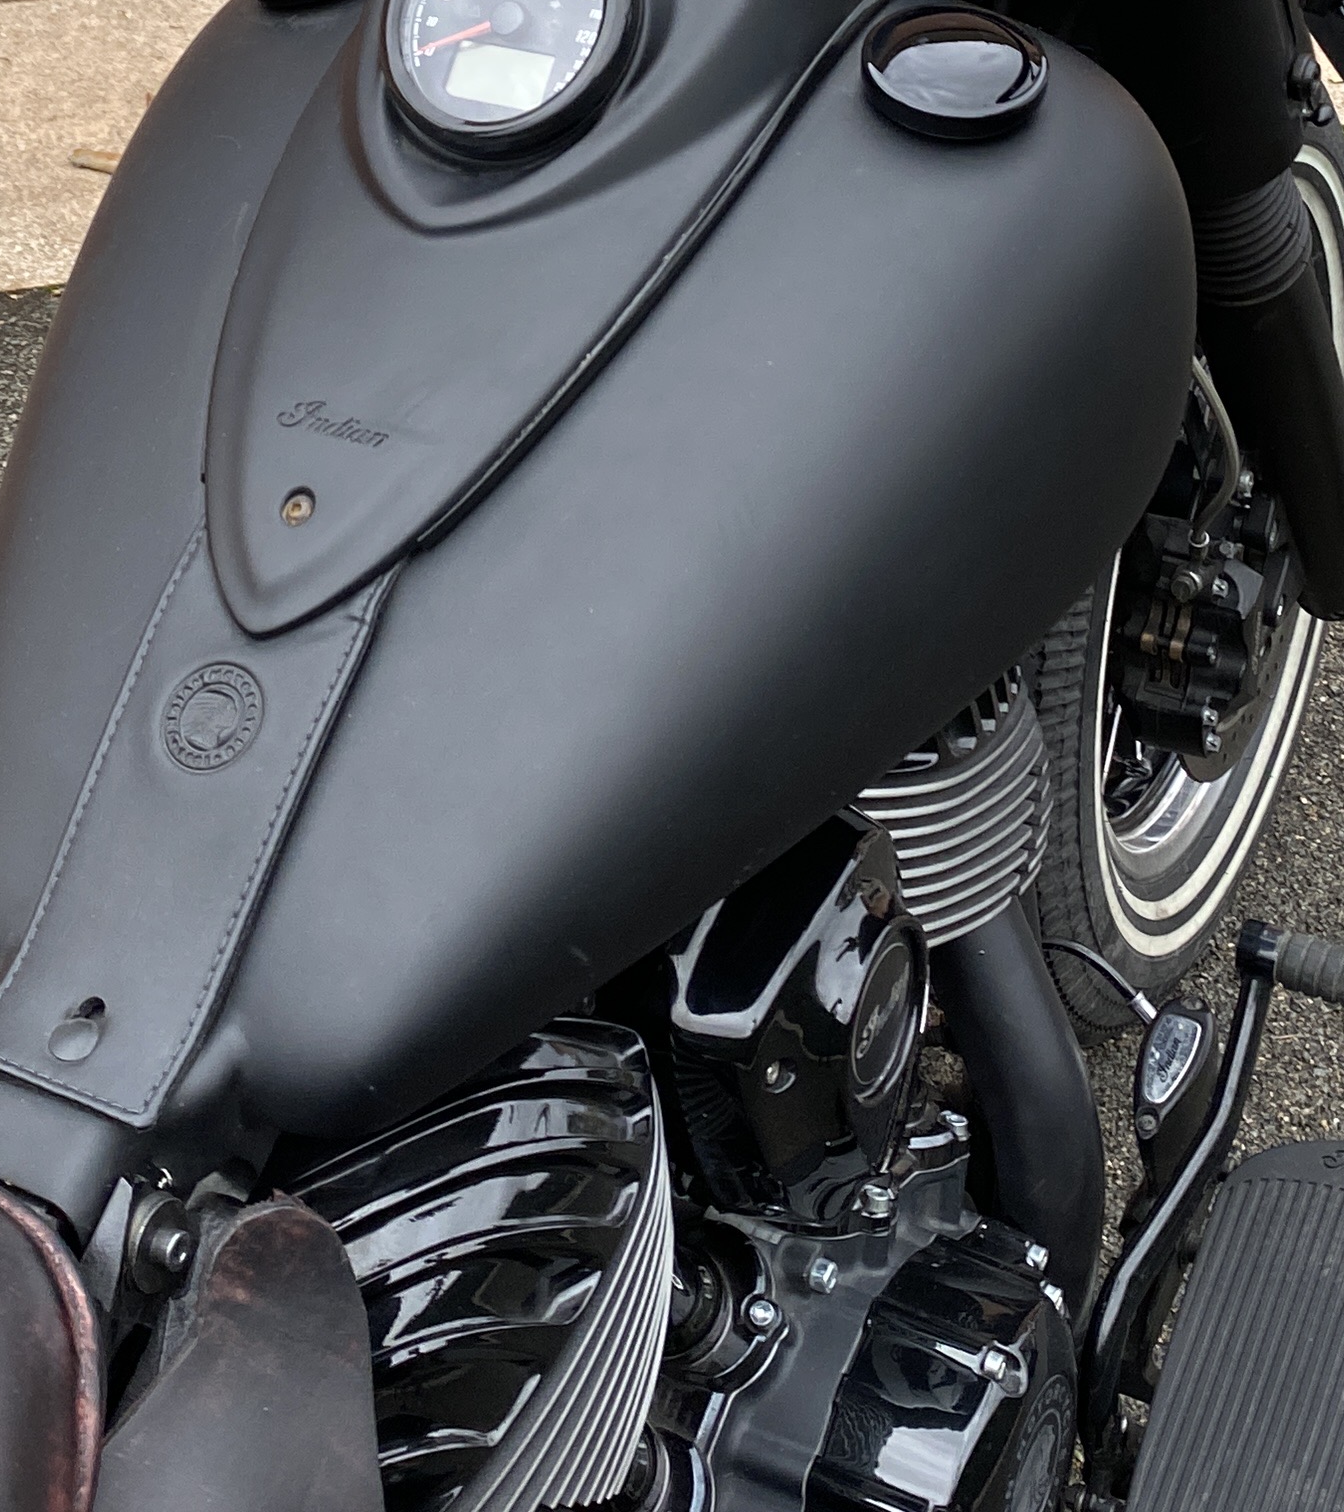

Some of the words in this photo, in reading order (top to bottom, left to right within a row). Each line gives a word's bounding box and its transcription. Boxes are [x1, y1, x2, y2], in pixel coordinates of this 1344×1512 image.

[575, 29, 597, 45] 120
[275, 399, 389, 448] Indian
[1156, 1036, 1183, 1084] Indian
